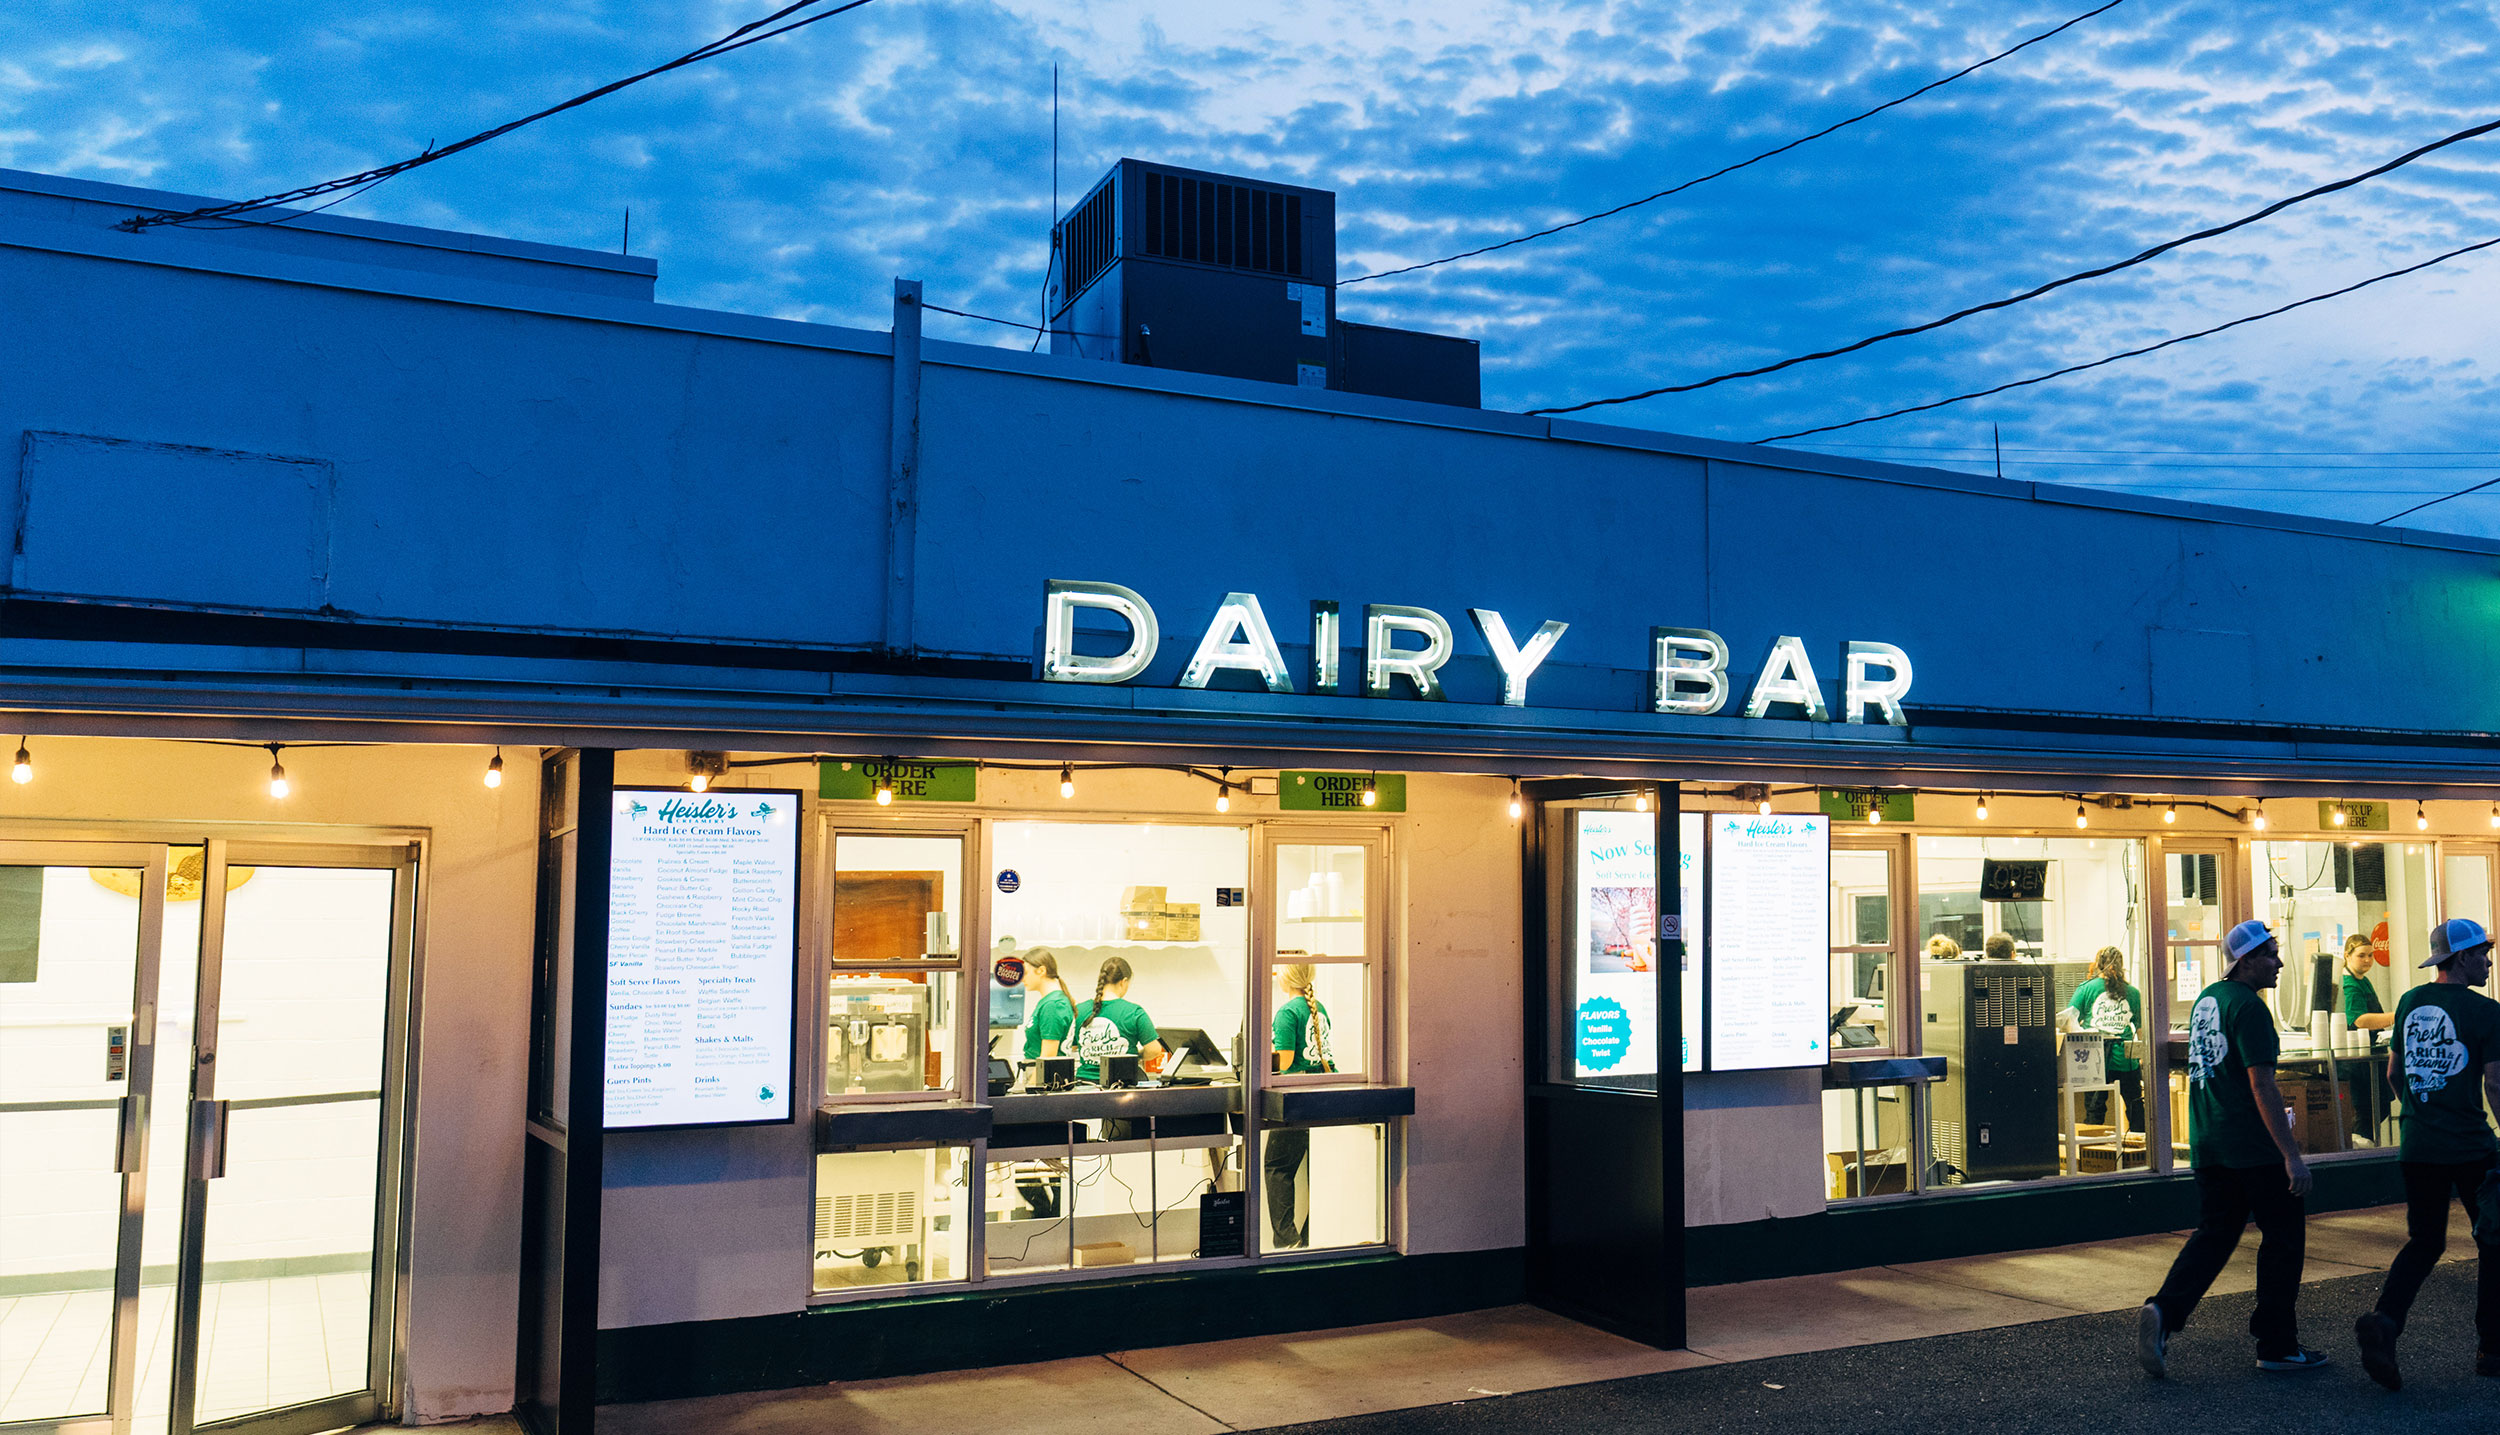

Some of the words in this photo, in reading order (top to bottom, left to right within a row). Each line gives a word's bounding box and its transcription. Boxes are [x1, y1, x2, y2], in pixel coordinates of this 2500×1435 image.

[1043, 579, 1570, 707] DAIRY
[1651, 625, 1913, 726] BAR
[862, 763, 935, 779] ORDER
[1314, 776, 1376, 791] ORDER
[1322, 792, 1365, 806] HERE
[1845, 791, 1889, 804] ORDER
[658, 798, 738, 823] Heisler's
[1852, 805, 1885, 817] HEE
[2360, 805, 2372, 815] UP
[644, 826, 668, 835] Hard
[672, 827, 687, 835] Ice
[691, 827, 723, 835] Cream
[727, 827, 761, 836] Flavors
[1747, 819, 1793, 838] Heisler's
[1591, 844, 1628, 864] Now
[1640, 871, 1651, 879] Ice
[1994, 864, 2045, 890] OPEN
[610, 978, 626, 986] Soft
[698, 976, 732, 985] Specialty
[609, 1002, 643, 1010] Sundaes
[2097, 1000, 2127, 1015] Fresh
[1581, 1011, 1620, 1020] FLAVORS
[2412, 1013, 2439, 1021] Country
[1083, 1024, 1118, 1045] Fresh
[1587, 1025, 1612, 1033] Vanilla
[2407, 1015, 2454, 1047] Fresh
[695, 1036, 721, 1044] Shakes
[1582, 1037, 1620, 1045] Chocolate
[1591, 1049, 1611, 1057] Twist
[2416, 1047, 2446, 1058] RICH
[2405, 1050, 2462, 1074] Creamy!
[695, 1076, 720, 1084] Drinks
